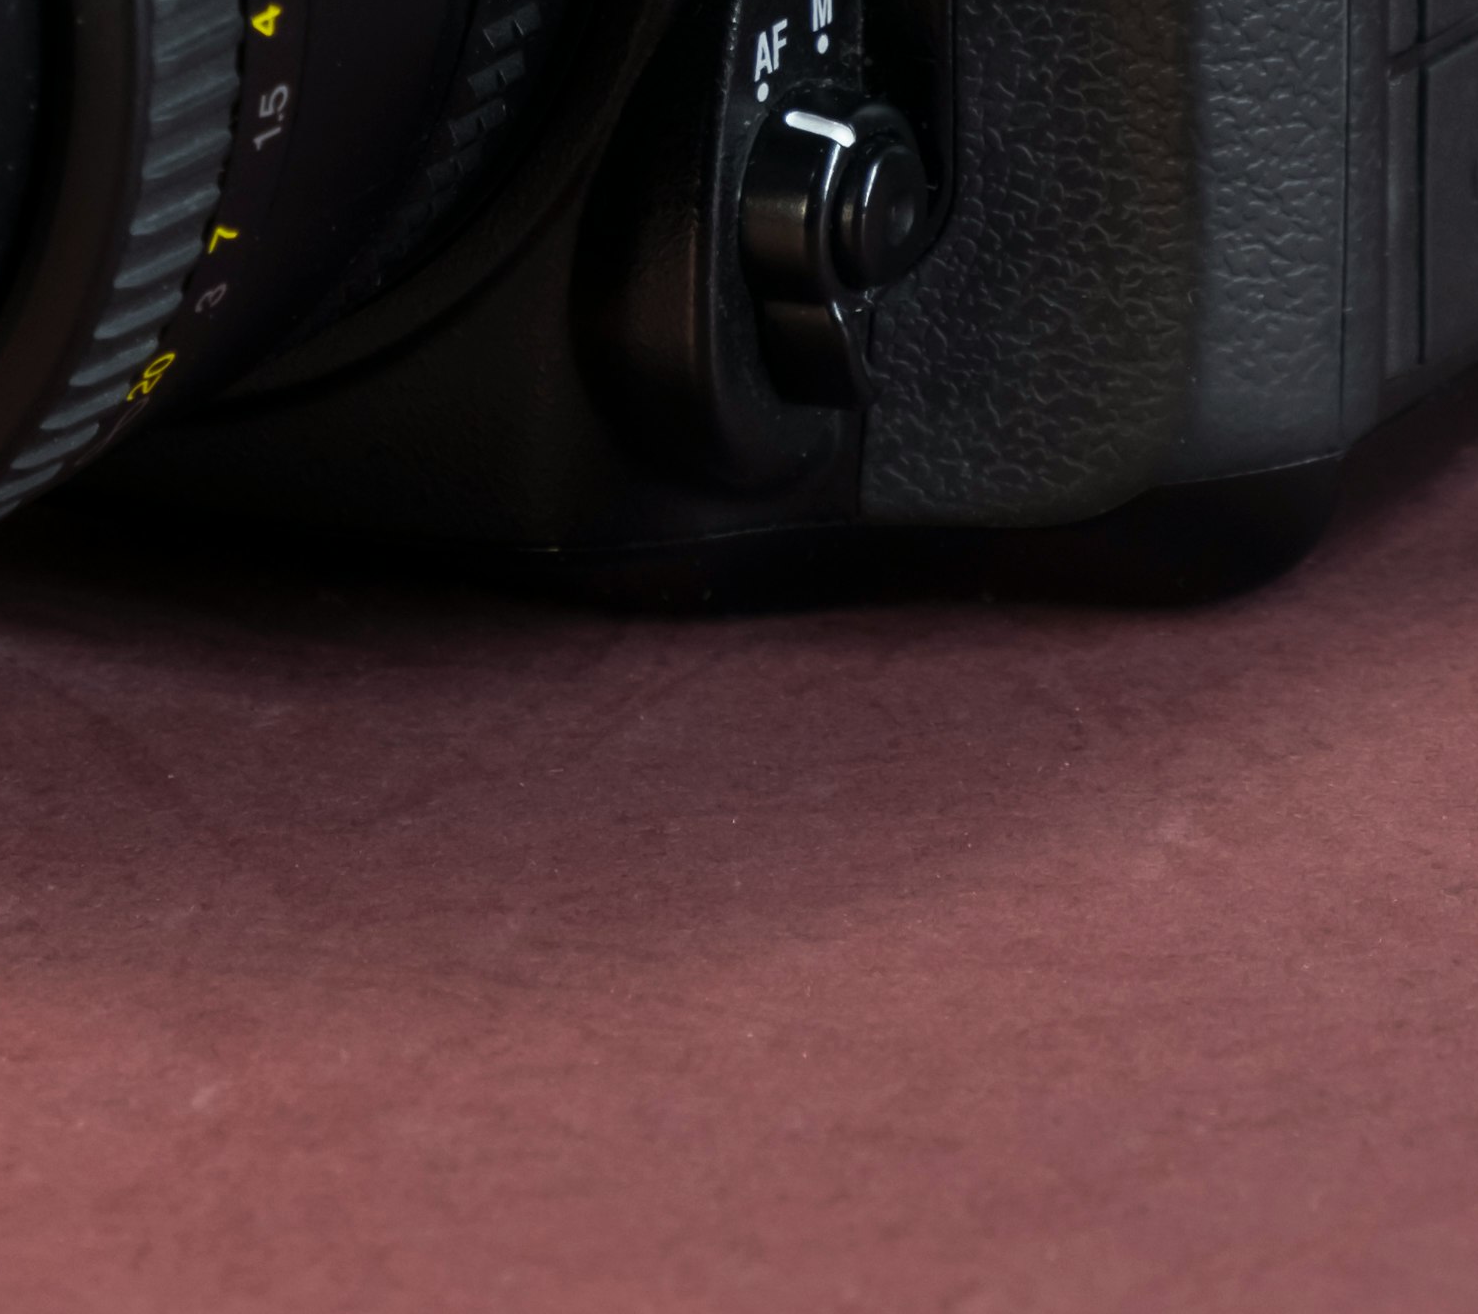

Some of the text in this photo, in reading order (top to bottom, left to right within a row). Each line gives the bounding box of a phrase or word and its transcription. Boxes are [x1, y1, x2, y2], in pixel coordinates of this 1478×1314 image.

[250, 4, 282, 38] 4
[754, 18, 788, 83] AF
[251, 83, 290, 151] 1.5
[207, 225, 238, 254] 7
[194, 282, 229, 314] 3
